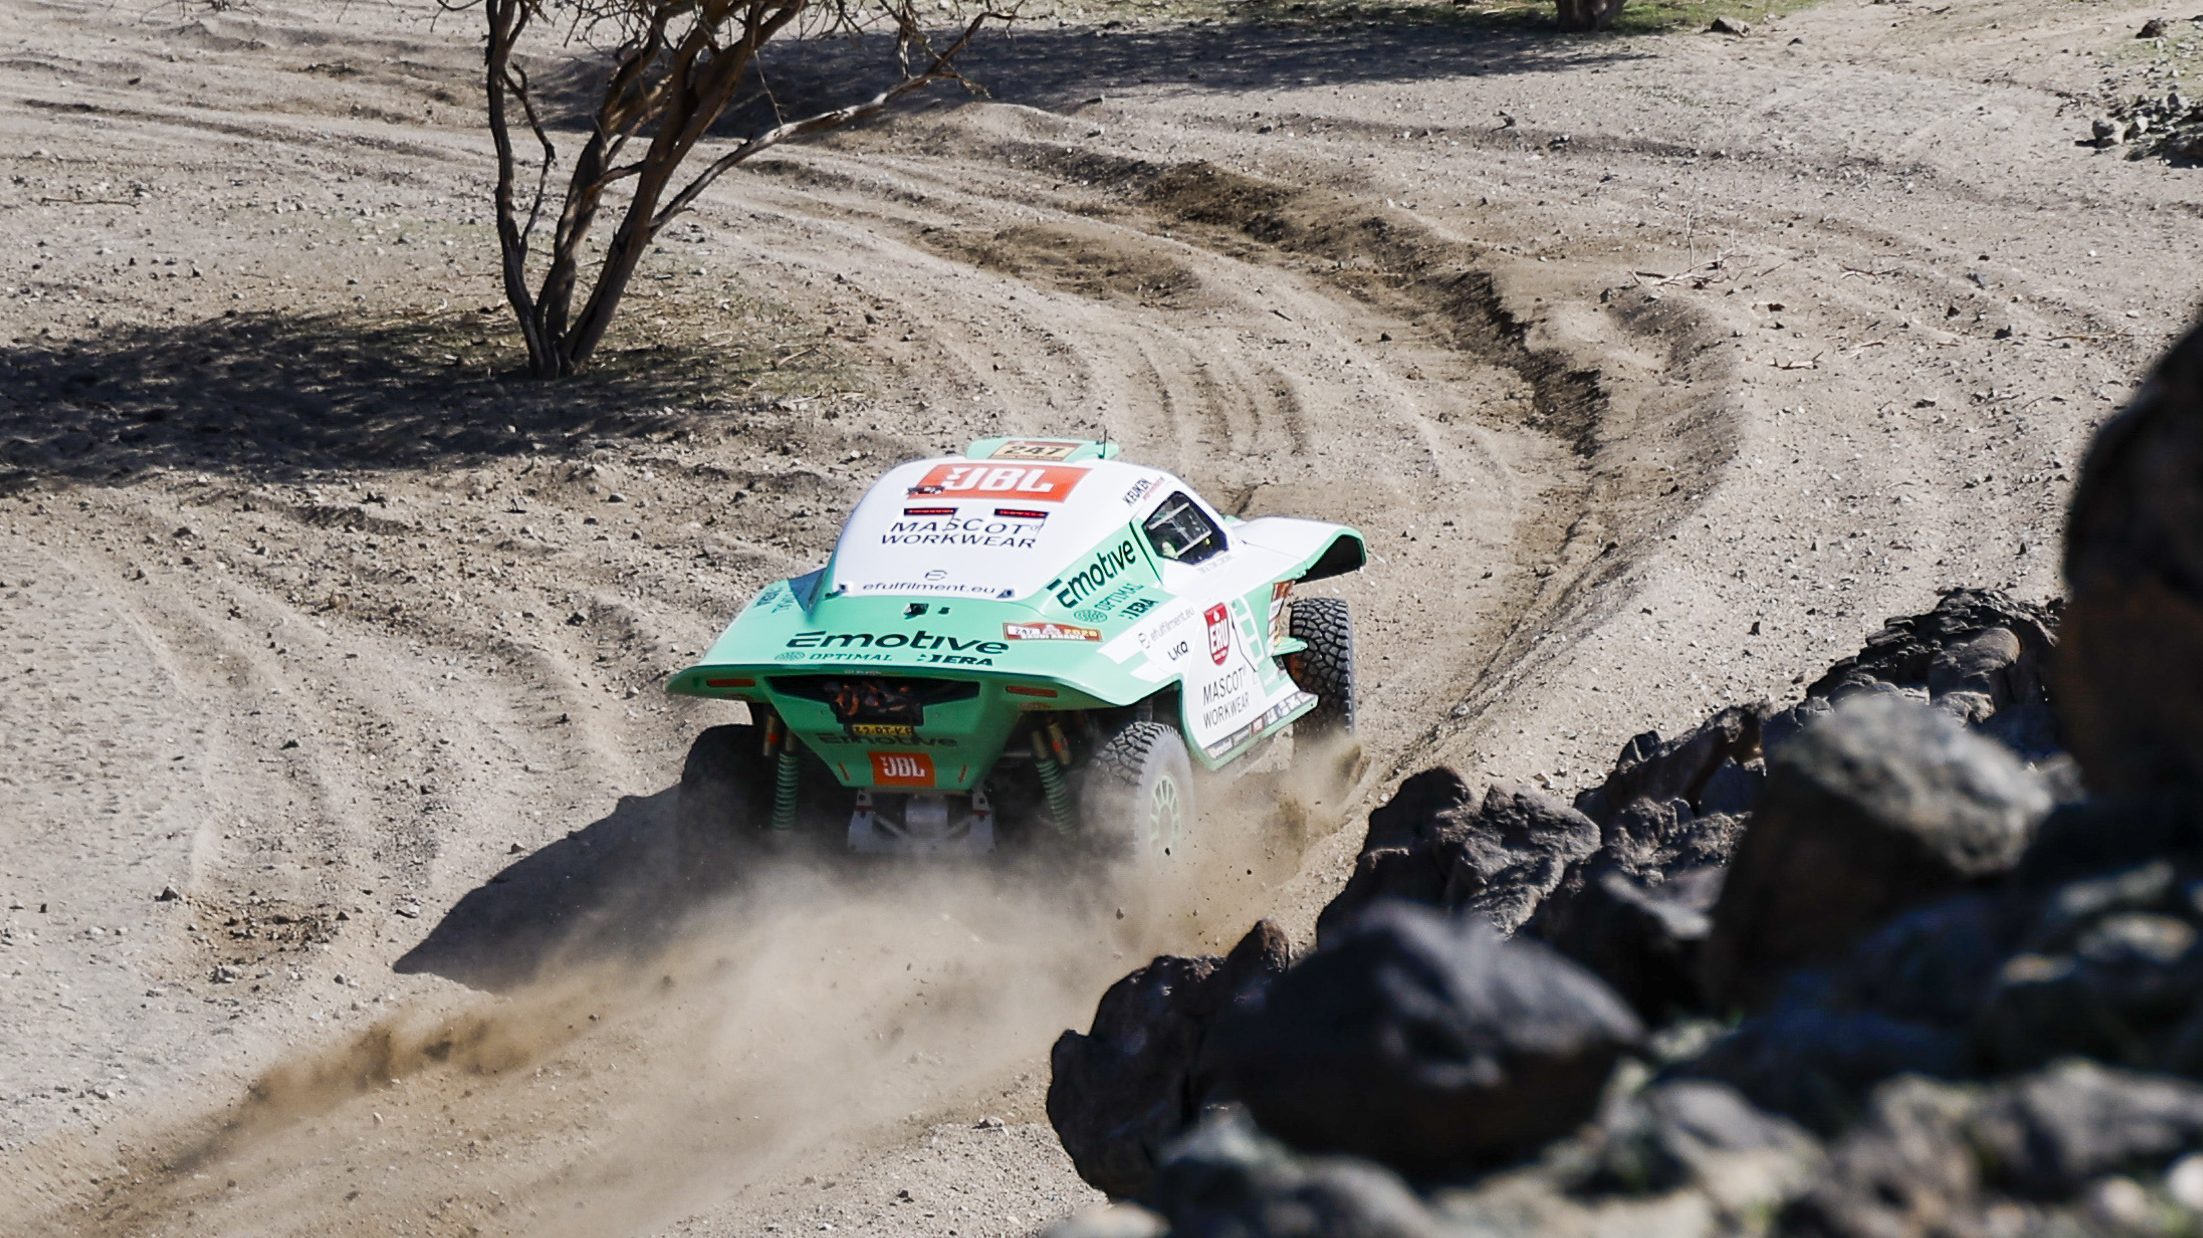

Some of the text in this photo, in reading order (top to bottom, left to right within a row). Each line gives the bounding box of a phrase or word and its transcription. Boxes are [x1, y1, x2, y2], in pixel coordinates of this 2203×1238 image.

[1004, 445, 1066, 455] 247
[941, 467, 1055, 492] JBL
[881, 534, 1036, 548] WORKWEAR
[1046, 540, 1136, 608] Emotive
[862, 582, 996, 594] efulfilment.eu
[1094, 583, 1144, 611] OPTIMAL
[786, 630, 1009, 655] Emotive
[1209, 619, 1228, 653] ERU
[809, 652, 894, 661] OPTIMAL
[1167, 641, 1189, 661] LKQ
[1203, 692, 1250, 729] WORKWEAR
[880, 757, 926, 777] JBL
